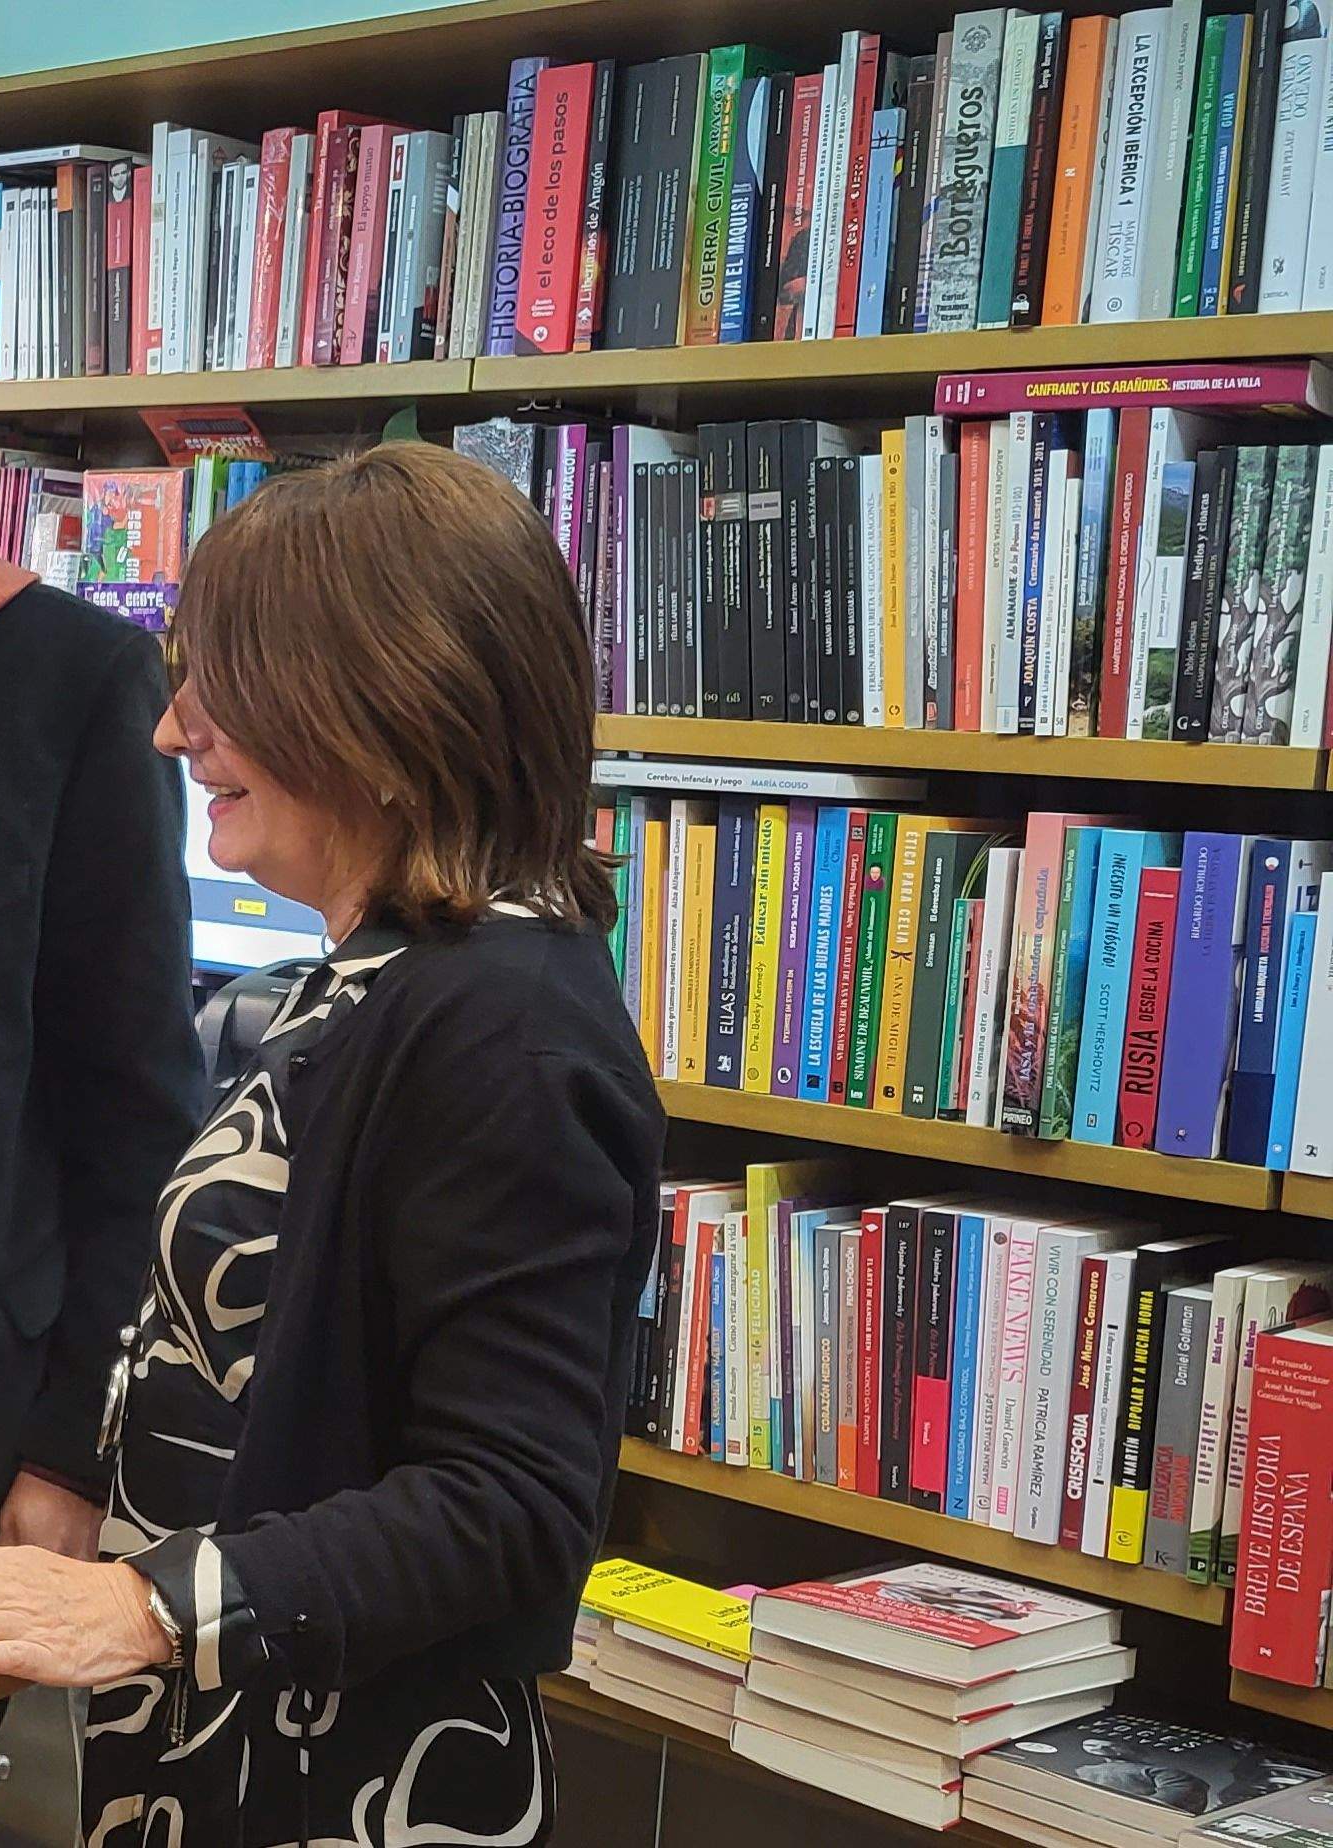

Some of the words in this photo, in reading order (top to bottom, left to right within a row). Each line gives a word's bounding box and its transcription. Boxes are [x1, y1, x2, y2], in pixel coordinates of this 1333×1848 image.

[1134, 34, 1151, 53] LA
[1123, 55, 1150, 135] EXCEPCIÓN
[1279, 53, 1297, 122] PLANETA
[1294, 53, 1312, 119] OCÉANO
[551, 92, 569, 154] pasos
[707, 75, 725, 157] ARAGÓN
[1221, 92, 1235, 128] GUARA
[364, 147, 374, 181] mutuo
[544, 160, 562, 190] los
[938, 86, 983, 259] Borregueros
[1119, 139, 1143, 195] IBÉRICA
[361, 185, 371, 217] apoyo
[588, 162, 605, 209] Aragón
[706, 158, 726, 212] CIVIL
[358, 221, 367, 231] El
[491, 74, 536, 340] HISTORIA-BIOGRAFÍA
[542, 195, 559, 220] de
[587, 213, 599, 229] de
[727, 197, 749, 255] MAQUIS!
[542, 226, 556, 264] eco
[698, 219, 720, 306] GUERRA
[1103, 220, 1122, 280] TISCAR
[537, 269, 553, 288] el
[579, 231, 599, 302] Libertarios
[726, 258, 743, 275] EL
[723, 280, 743, 317] ¡VIVA
[1026, 380, 1080, 397] CANFRANC
[1081, 381, 1090, 396] Y
[1091, 379, 1111, 395] LOS
[1112, 376, 1171, 394] ARAÑONES.
[1172, 378, 1210, 392] HISTORIA
[1211, 377, 1223, 389] DE
[1224, 377, 1236, 389] LA
[1236, 376, 1261, 388] VILLA
[1035, 441, 1045, 461] 2011
[1033, 468, 1043, 488] 1911
[1197, 493, 1210, 531] cloacas
[1030, 529, 1039, 541] de
[1028, 542, 1040, 587] Centenario
[1191, 542, 1206, 581] Medios
[1026, 597, 1038, 633] COSTA
[1185, 621, 1198, 651] Iglesias
[1023, 635, 1036, 686] JOAQUÍN
[1184, 653, 1196, 675] Pablo
[751, 778, 777, 789] MARÍA
[778, 780, 808, 790] COUSO
[760, 819, 772, 865] miedo
[902, 831, 918, 866] ÉTICA
[758, 868, 769, 891] sin
[900, 872, 915, 902] PARA
[1108, 852, 1127, 897] ¡NECESITO
[1195, 847, 1209, 892] ROBLEDO
[754, 893, 768, 945] Educar
[817, 886, 834, 926] MADRES
[1107, 899, 1123, 918] UN
[1190, 895, 1204, 939] RICARDO
[897, 908, 912, 944] CELIA
[1102, 921, 1120, 968] FILÓSOFO!
[1145, 920, 1164, 964] COCINA
[814, 928, 830, 968] BUENAS
[925, 933, 936, 968] Srinivasan
[754, 961, 765, 1000] Kennedy
[813, 970, 826, 989] LAS
[892, 973, 904, 998] ANA
[1143, 967, 1159, 981] LA
[719, 992, 736, 1035] ELLAS
[752, 1002, 763, 1030] Becky
[812, 992, 825, 1005] DE
[890, 1001, 902, 1018] DE
[1096, 983, 1111, 1018] SCOTT
[1138, 984, 1156, 1022] DESDE
[750, 1032, 760, 1052] Dra.
[809, 1008, 825, 1051] ESCUELA
[978, 1012, 988, 1033] otra
[808, 1053, 822, 1066] LA
[886, 1022, 900, 1071] MIGUEL
[974, 1035, 986, 1078] Hermana
[1089, 1021, 1108, 1093] HERSHOVITZ
[1124, 1029, 1159, 1095] RUSIA
[1007, 1239, 1034, 1303] FAKE
[1047, 1245, 1061, 1278] VIVIR
[752, 1269, 761, 1335] FELICIDAD
[1045, 1280, 1059, 1307] CON
[1082, 1271, 1100, 1326] Camarero
[1136, 1290, 1155, 1325] HONRA
[1002, 1310, 1029, 1384] NEWS
[1040, 1308, 1058, 1376] SERENIDAD
[1080, 1328, 1095, 1362] María
[1132, 1326, 1150, 1364] MUCHA
[1179, 1304, 1195, 1351] Goleman
[821, 1338, 830, 1382] HEROICO
[1077, 1365, 1091, 1390] José
[1173, 1353, 1191, 1386] Daniel
[1272, 1356, 1313, 1371] Fernando
[752, 1362, 762, 1419] MIRADAS
[960, 1368, 970, 1407] CONTROL
[821, 1384, 830, 1433] CORAZÓN
[959, 1409, 968, 1430] BAJO
[1004, 1398, 1016, 1432] Daniel
[1033, 1387, 1050, 1441] PATRICIA
[1127, 1386, 1147, 1431] BIPOLAR
[753, 1425, 761, 1436] 15
[955, 1432, 967, 1472] ANSIEDAD
[999, 1434, 1015, 1470] Gascón
[1029, 1444, 1045, 1498] RAMÍREZ
[1066, 1413, 1090, 1500] CRISISFOBIA
[1124, 1436, 1141, 1476] MARTÍN
[955, 1475, 965, 1485] TU
[1251, 1433, 1282, 1539] HISTORIA
[1277, 1471, 1310, 1546] ESPAÑA
[1243, 1542, 1271, 1616] BREVE
[1275, 1550, 1301, 1592] DE
